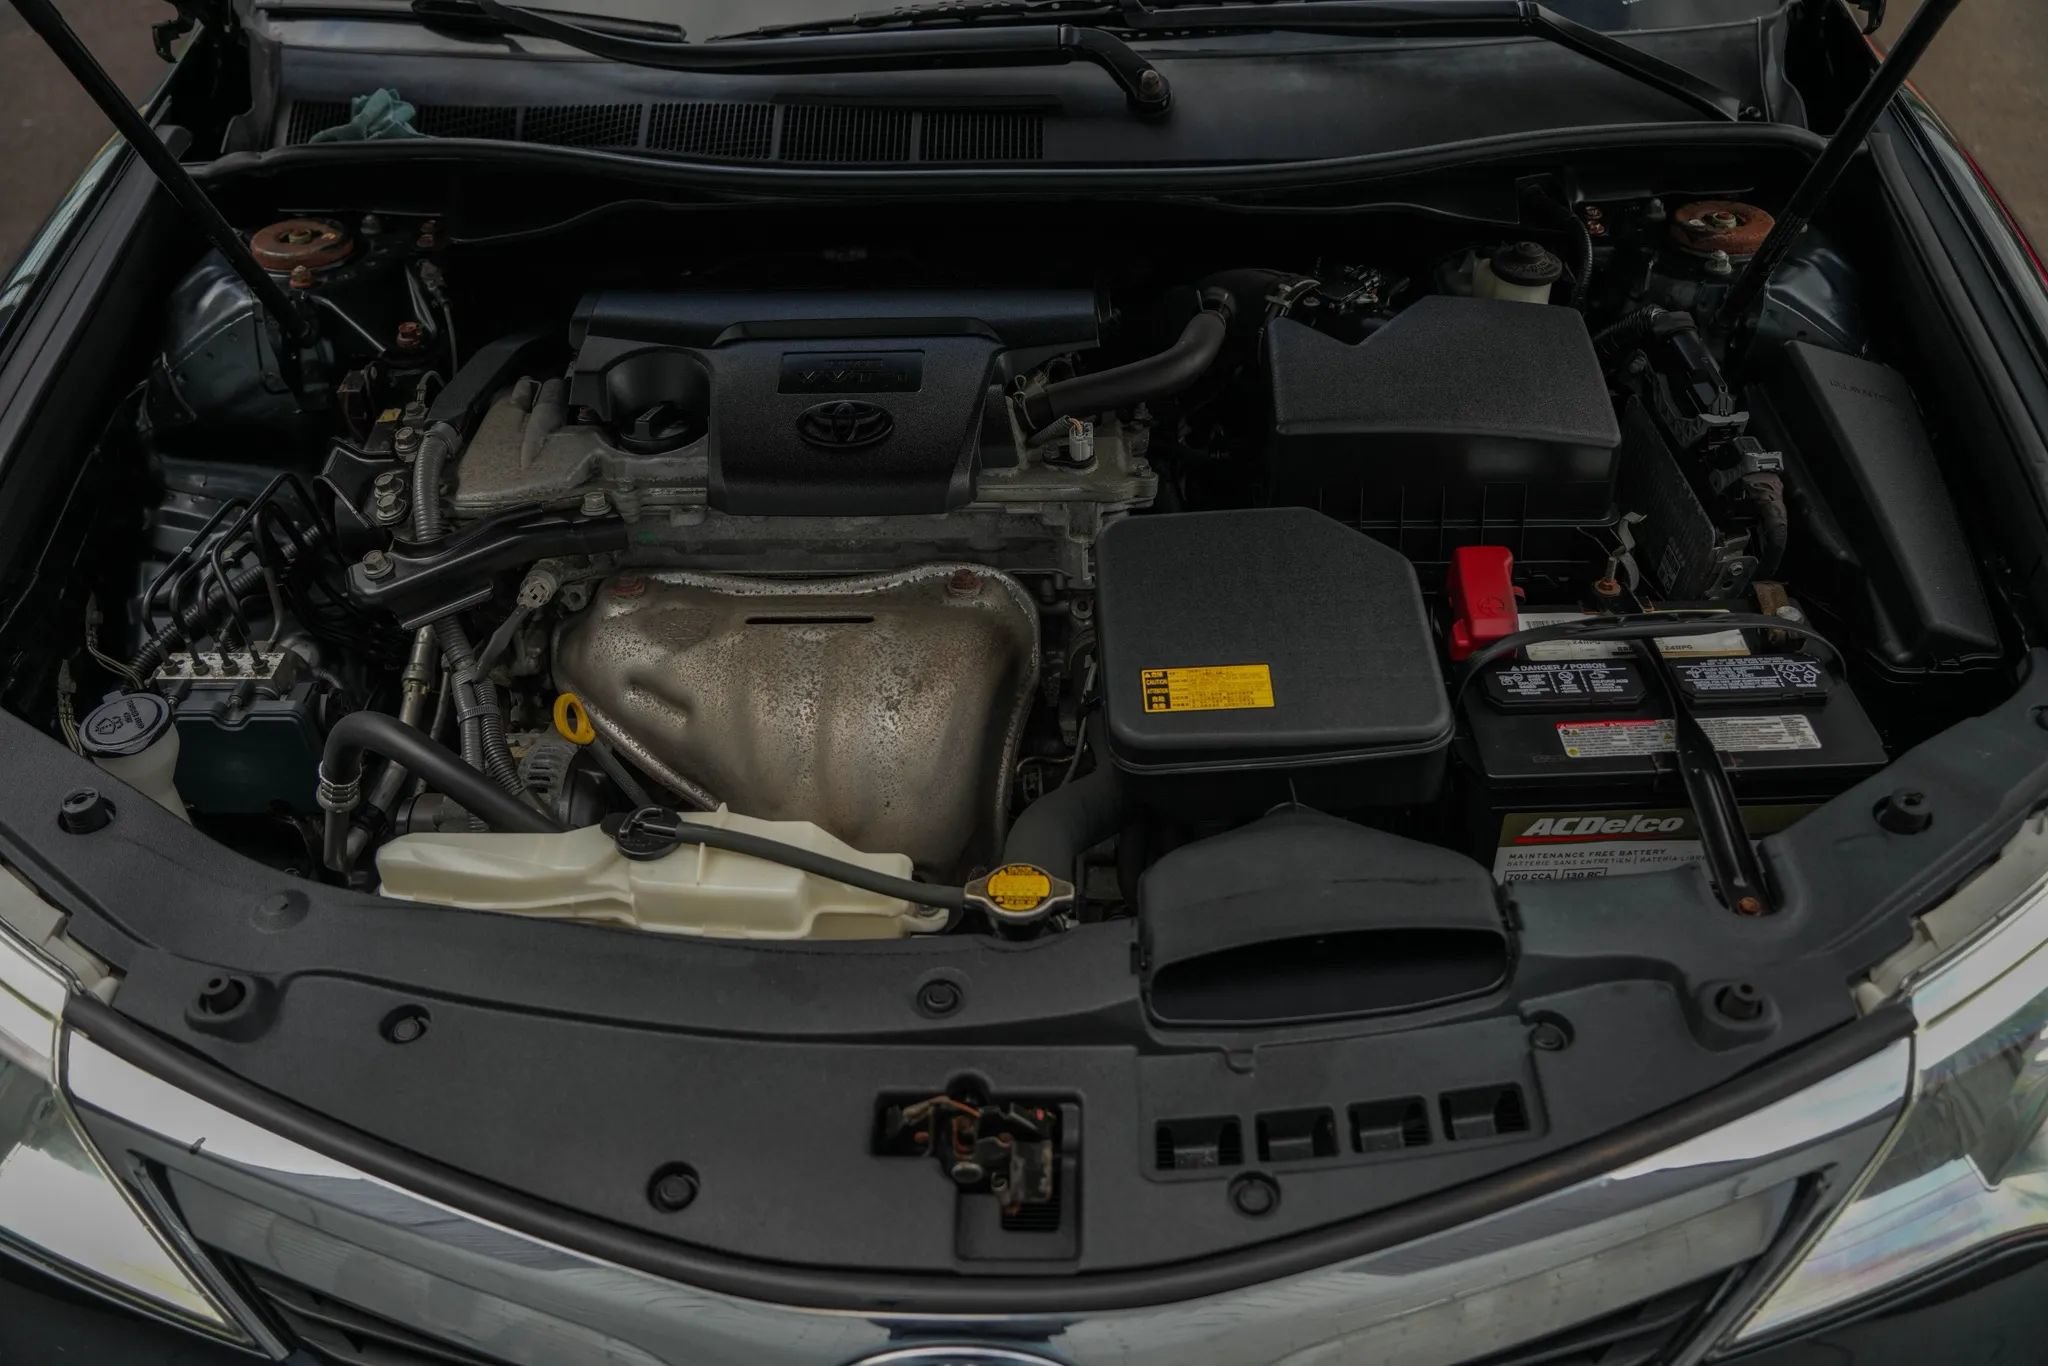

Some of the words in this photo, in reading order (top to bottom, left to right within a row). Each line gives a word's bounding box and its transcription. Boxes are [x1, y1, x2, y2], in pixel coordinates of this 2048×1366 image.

[1520, 664, 1561, 672] DANGER
[1570, 662, 1607, 670] POISON
[1521, 816, 1685, 837] ACDelco
[1508, 852, 1585, 860] MAINTENANCE
[1588, 850, 1616, 858] FREE
[1618, 848, 1668, 857] BATTERY
[1507, 873, 1529, 881] 700
[1531, 872, 1552, 881] CCA
[1566, 872, 1585, 880] 130
